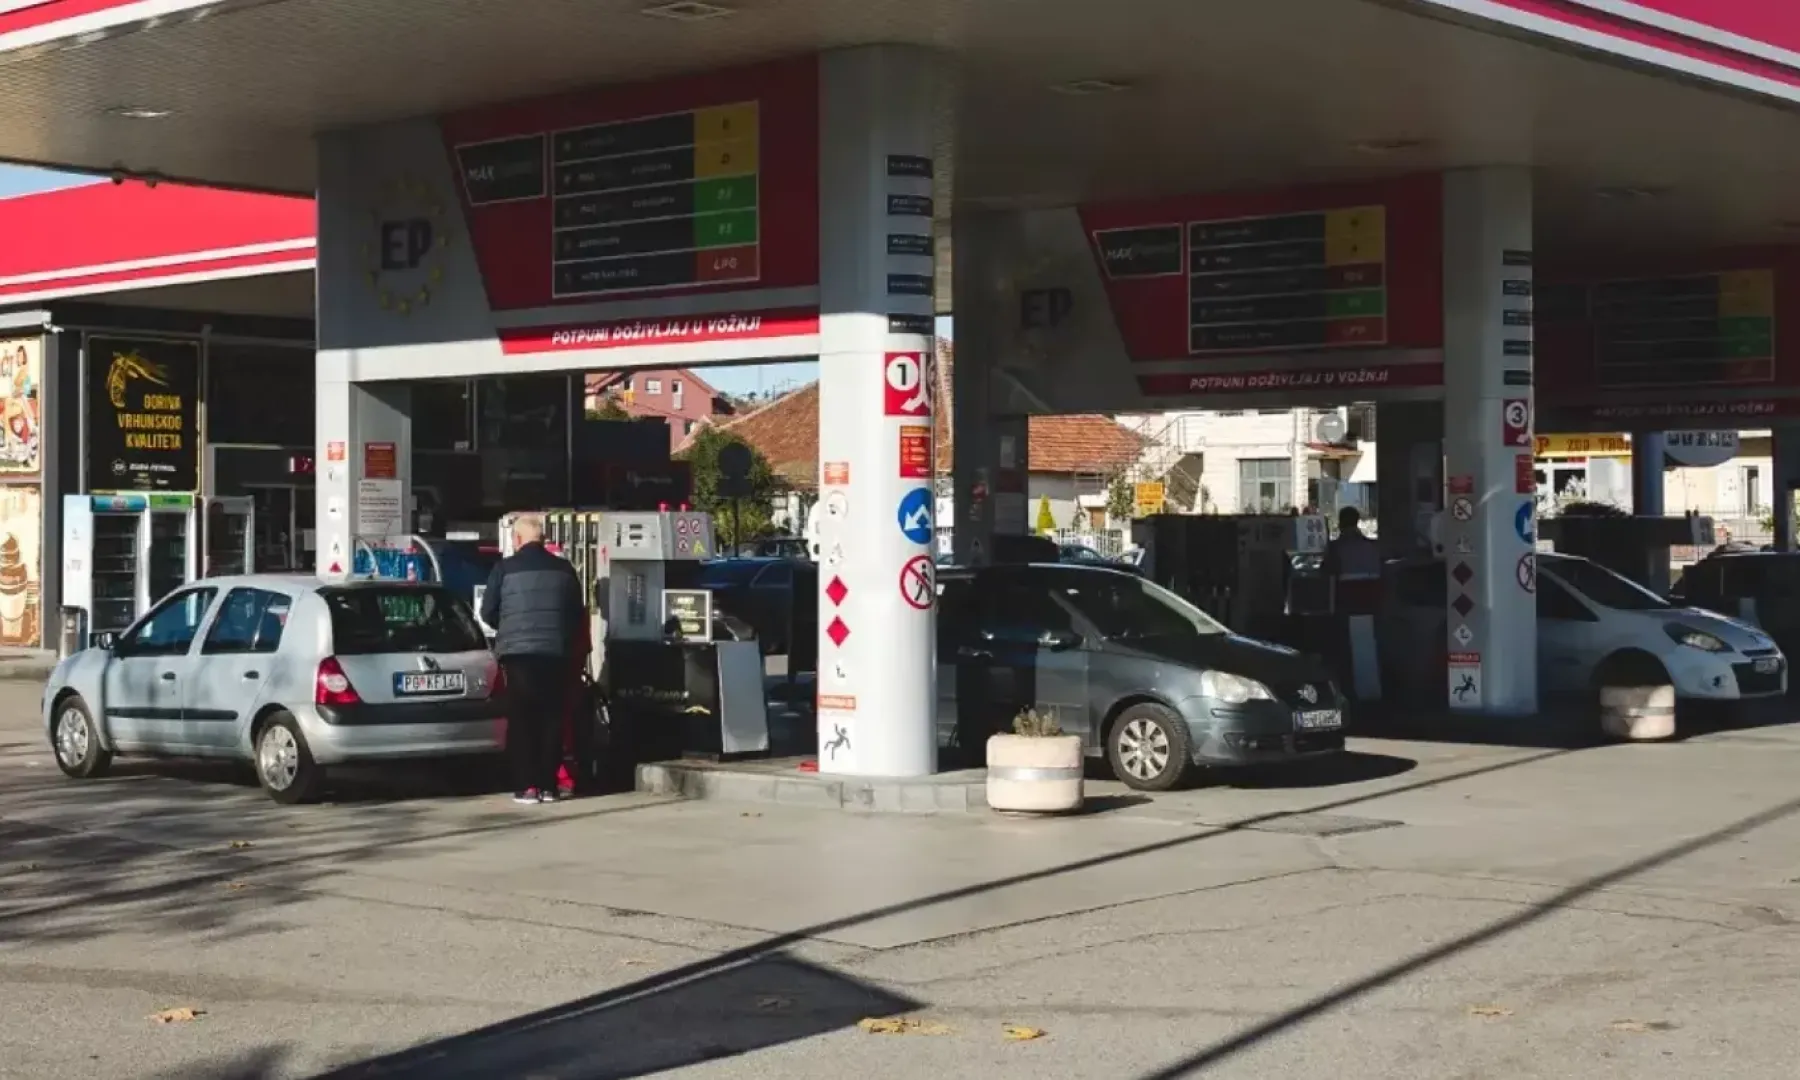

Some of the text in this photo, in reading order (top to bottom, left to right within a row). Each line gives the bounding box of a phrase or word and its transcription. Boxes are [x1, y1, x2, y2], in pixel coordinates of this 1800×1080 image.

[381, 217, 432, 270] EP
[713, 257, 738, 271] LPG
[1020, 287, 1073, 329] EP
[551, 314, 762, 345] POTPUNI DOŽIVLJAJ U VOŽNJI
[896, 363, 906, 386] 1
[1190, 376, 1244, 391] POTPUNI
[116, 413, 182, 430] VRHUNSKOG
[1511, 406, 1523, 424] 3
[125, 432, 182, 450] KVALITETA
